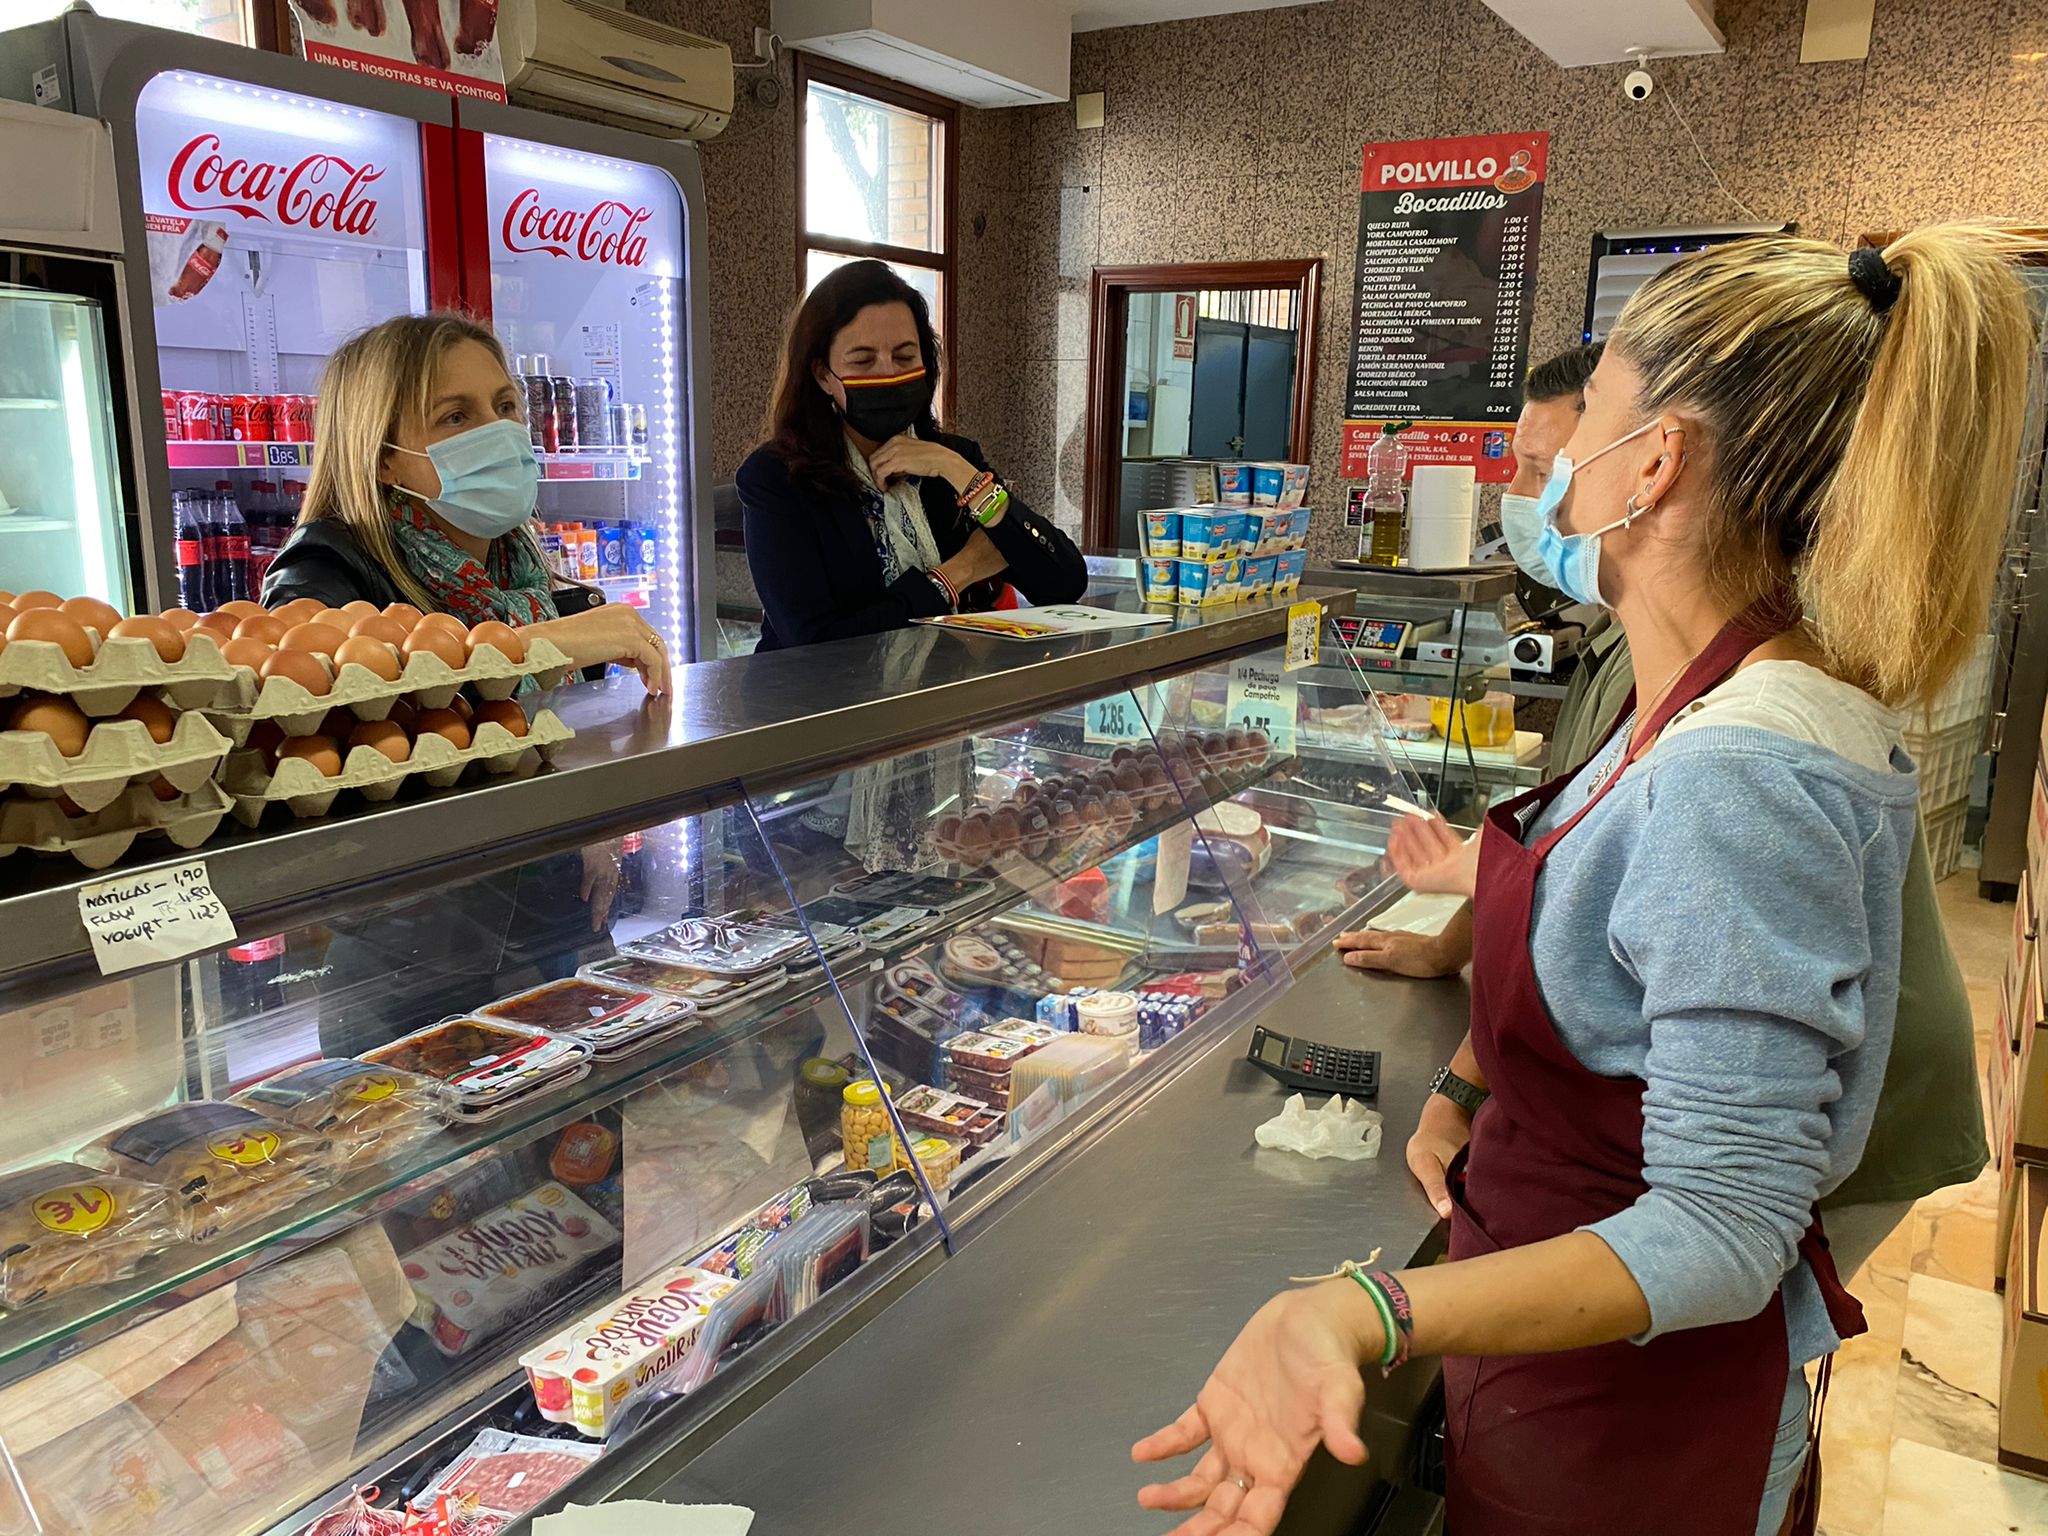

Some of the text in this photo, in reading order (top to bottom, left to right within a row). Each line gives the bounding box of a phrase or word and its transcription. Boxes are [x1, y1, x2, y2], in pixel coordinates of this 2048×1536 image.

[313, 52, 502, 102] UNA DE NOSOTRAS SE VA CONTIGO
[1381, 157, 1497, 184] POLVILLO
[168, 133, 388, 236] Coca-Cola
[1394, 191, 1508, 214] Bocadillos
[503, 188, 655, 268] Coca-Cola
[1367, 222, 1390, 231] QUESO
[1387, 229, 1428, 237] CAMPOFRIO
[1522, 225, 1528, 233] €
[1366, 239, 1408, 247] MORTADELA
[1409, 237, 1458, 246] CASADEMONT
[1365, 248, 1397, 256] CHOPPED
[1399, 247, 1440, 255] CAMPOFRIO
[1364, 257, 1408, 265] SALCHICHÓN
[1519, 262, 1524, 270] €
[1362, 292, 1388, 300] SALAMI
[1361, 301, 1393, 309] PECHUGA
[1404, 309, 1431, 317] IBÉRICA
[1457, 317, 1482, 325] TURÓN
[1357, 363, 1380, 371] JAMÓN
[1390, 370, 1416, 378] IBÉRICO
[1400, 379, 1427, 387] IBÉRICO
[1487, 405, 1504, 413] 0.20
[1352, 430, 1370, 439] Con
[1396, 432, 1429, 441] cadillo
[1237, 667, 1280, 684] 1/4 Pechuga
[1247, 682, 1277, 692] de pavo
[1243, 688, 1281, 702] Campofrio
[174, 867, 204, 887] 1,90
[189, 901, 220, 921] 1,25
[586, 1295, 658, 1350] SURTIDO
[637, 1288, 703, 1347] YOGUR
[635, 1335, 686, 1388] YOGUR
